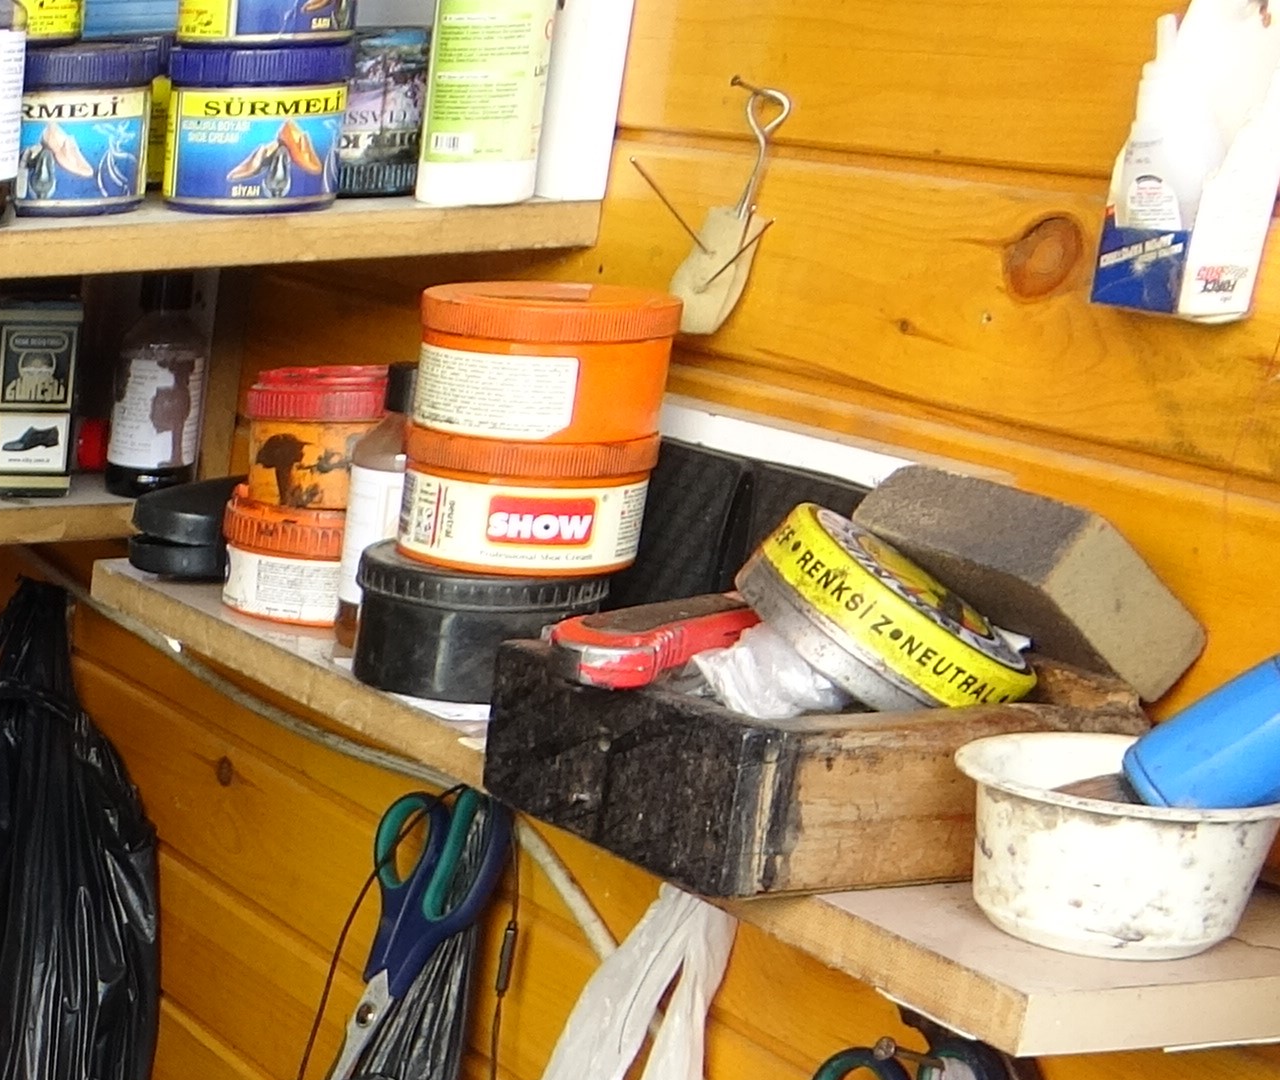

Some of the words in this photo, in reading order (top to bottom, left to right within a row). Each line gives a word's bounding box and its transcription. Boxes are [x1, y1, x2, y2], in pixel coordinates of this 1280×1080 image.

[22, 97, 121, 119] RMELİ
[204, 91, 343, 117] SÜRMELİ
[487, 511, 593, 540] SHOW
[796, 549, 893, 636] RENKSİZ
[899, 635, 995, 703] NEUTRAL
